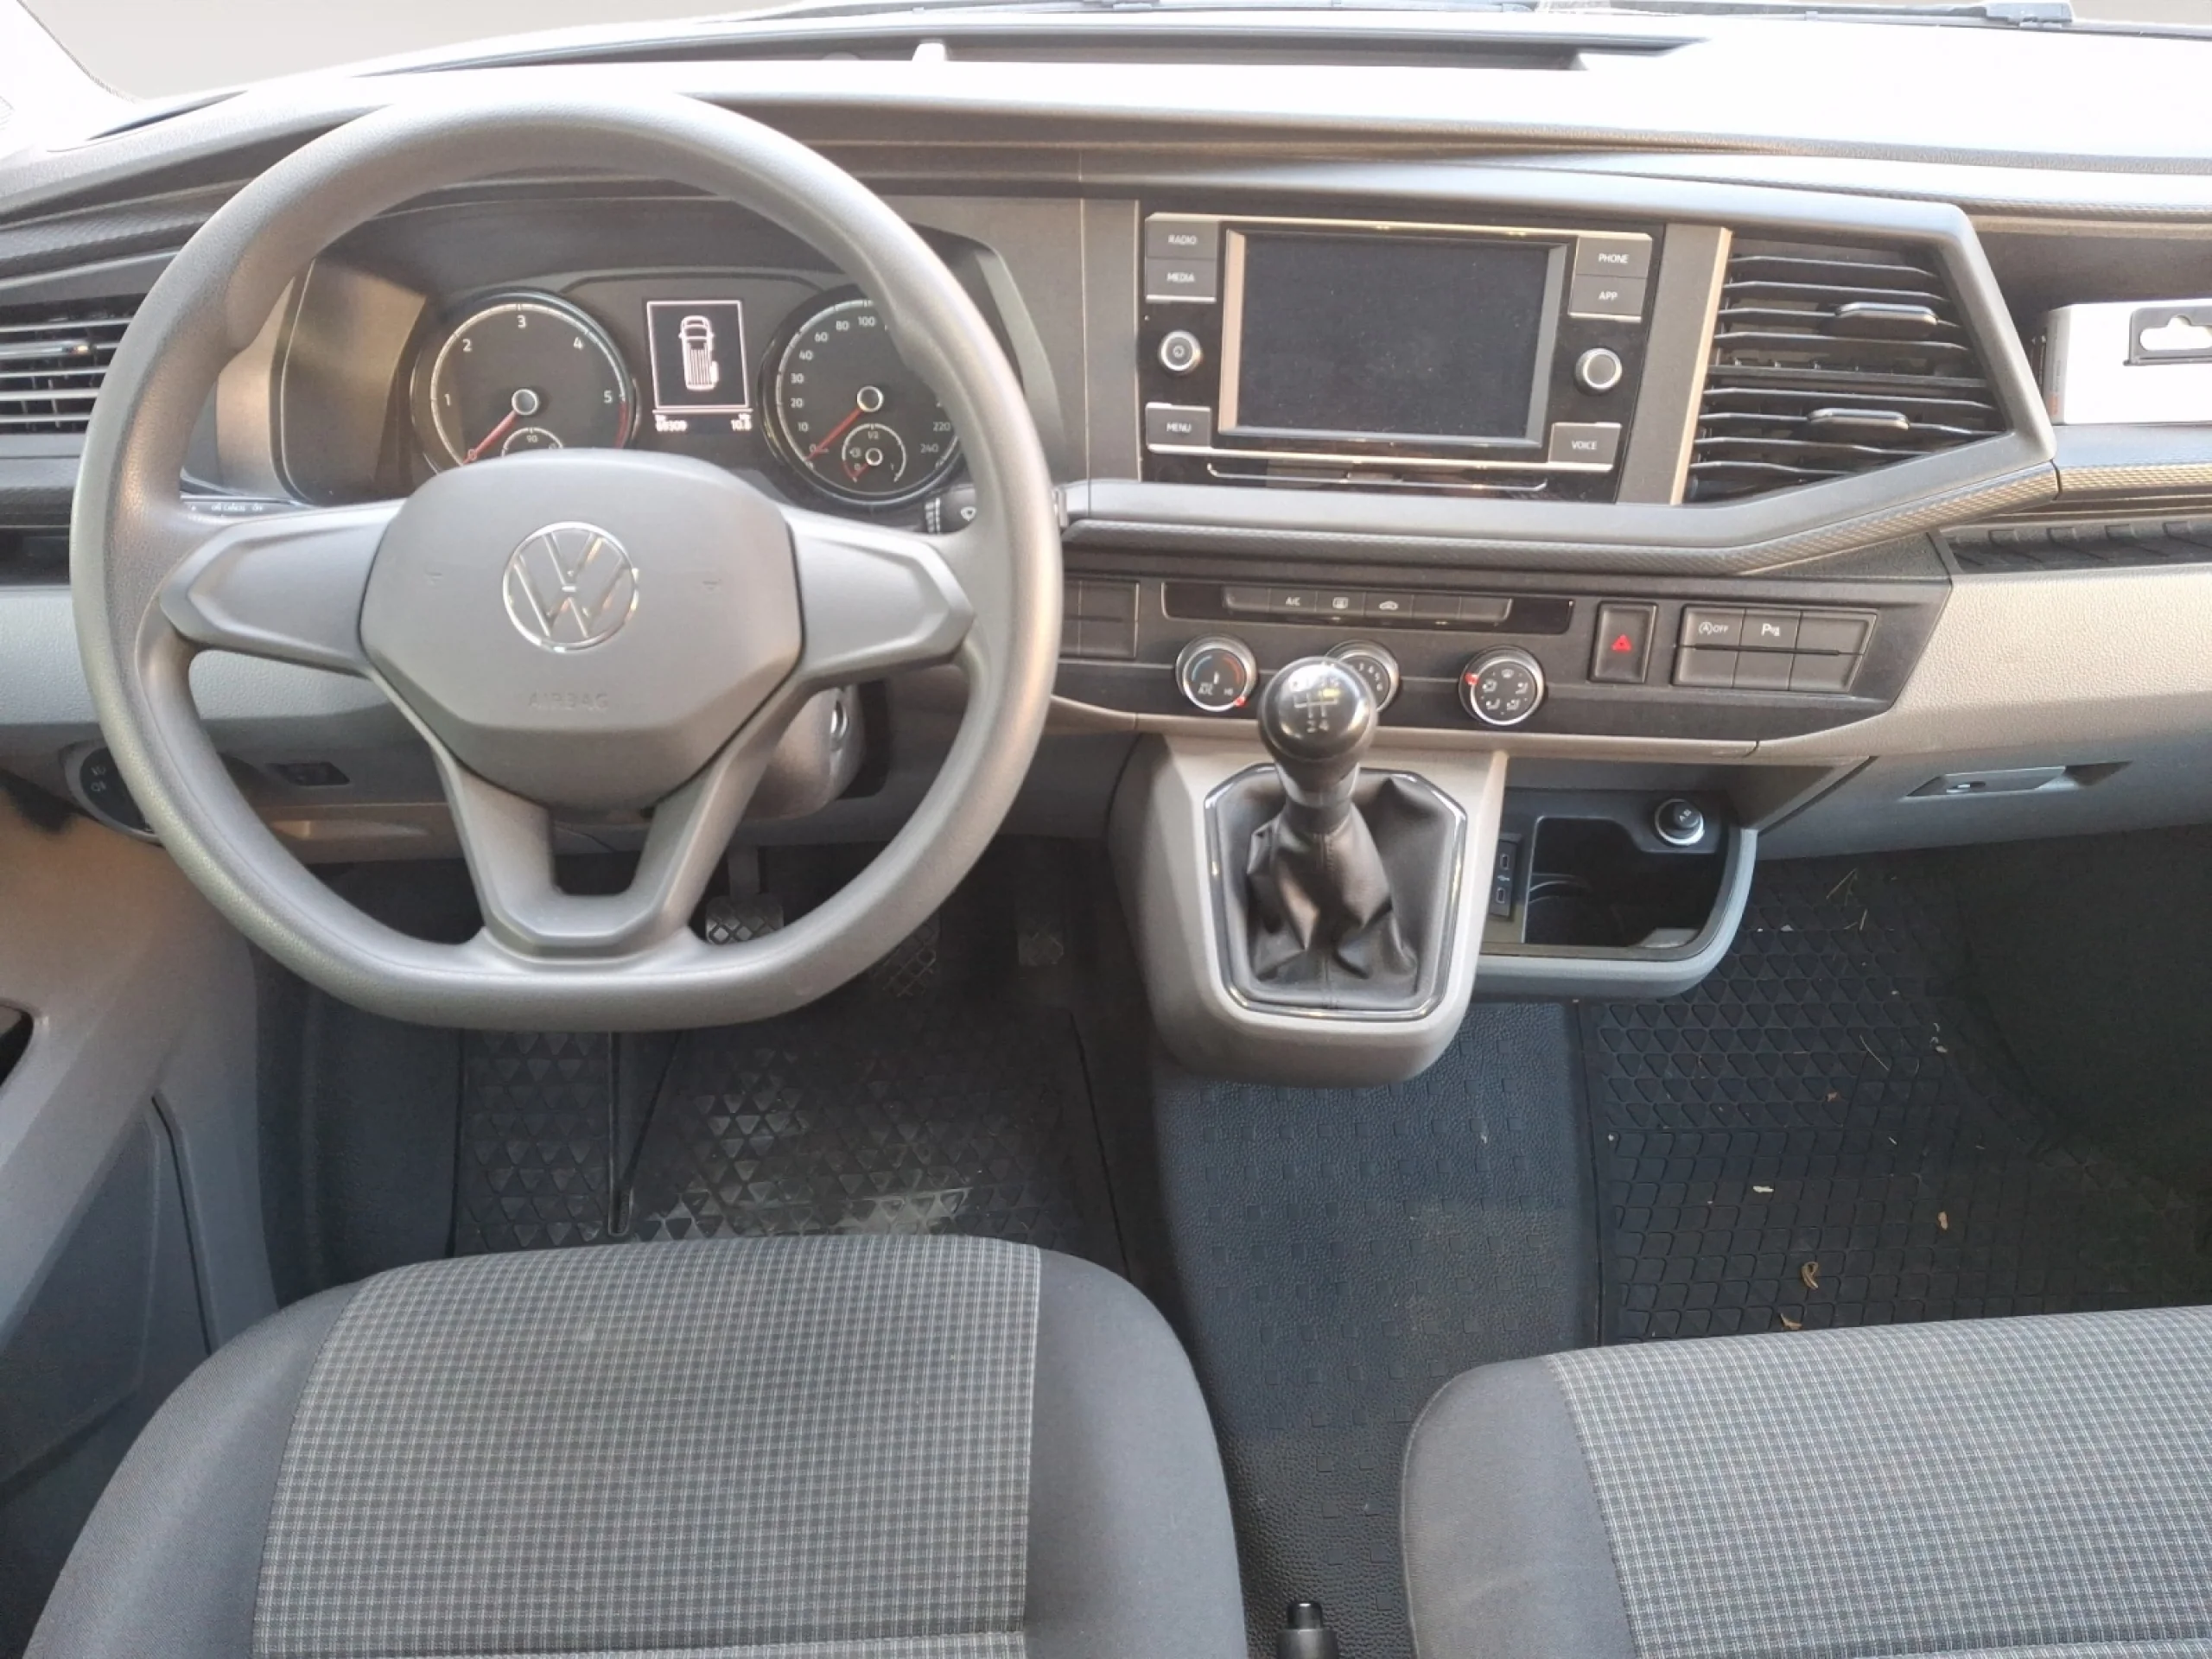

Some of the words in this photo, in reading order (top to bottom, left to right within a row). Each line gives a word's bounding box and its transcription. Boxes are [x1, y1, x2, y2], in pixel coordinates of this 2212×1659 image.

[1168, 234, 1197, 245] RADIO
[1599, 253, 1630, 264] PHONE
[1166, 272, 1195, 283] MEDIA
[1599, 291, 1618, 301] APP
[518, 315, 527, 328] 3
[836, 321, 849, 331] 80
[858, 316, 875, 327] 100
[815, 332, 828, 342] 60
[462, 339, 473, 353] 2
[573, 337, 584, 350] 4
[799, 350, 813, 360] 40
[791, 373, 804, 384] 30
[444, 394, 451, 406] 1
[603, 391, 613, 404] 5
[791, 398, 803, 409] 20
[798, 423, 809, 432] 10
[933, 422, 951, 432] 220
[1166, 423, 1192, 433] MENU
[526, 435, 538, 443] 90
[920, 443, 938, 454] 240
[1572, 441, 1598, 450] VOICE
[1285, 596, 1300, 607] A/C
[528, 693, 610, 711] AIRBAG
